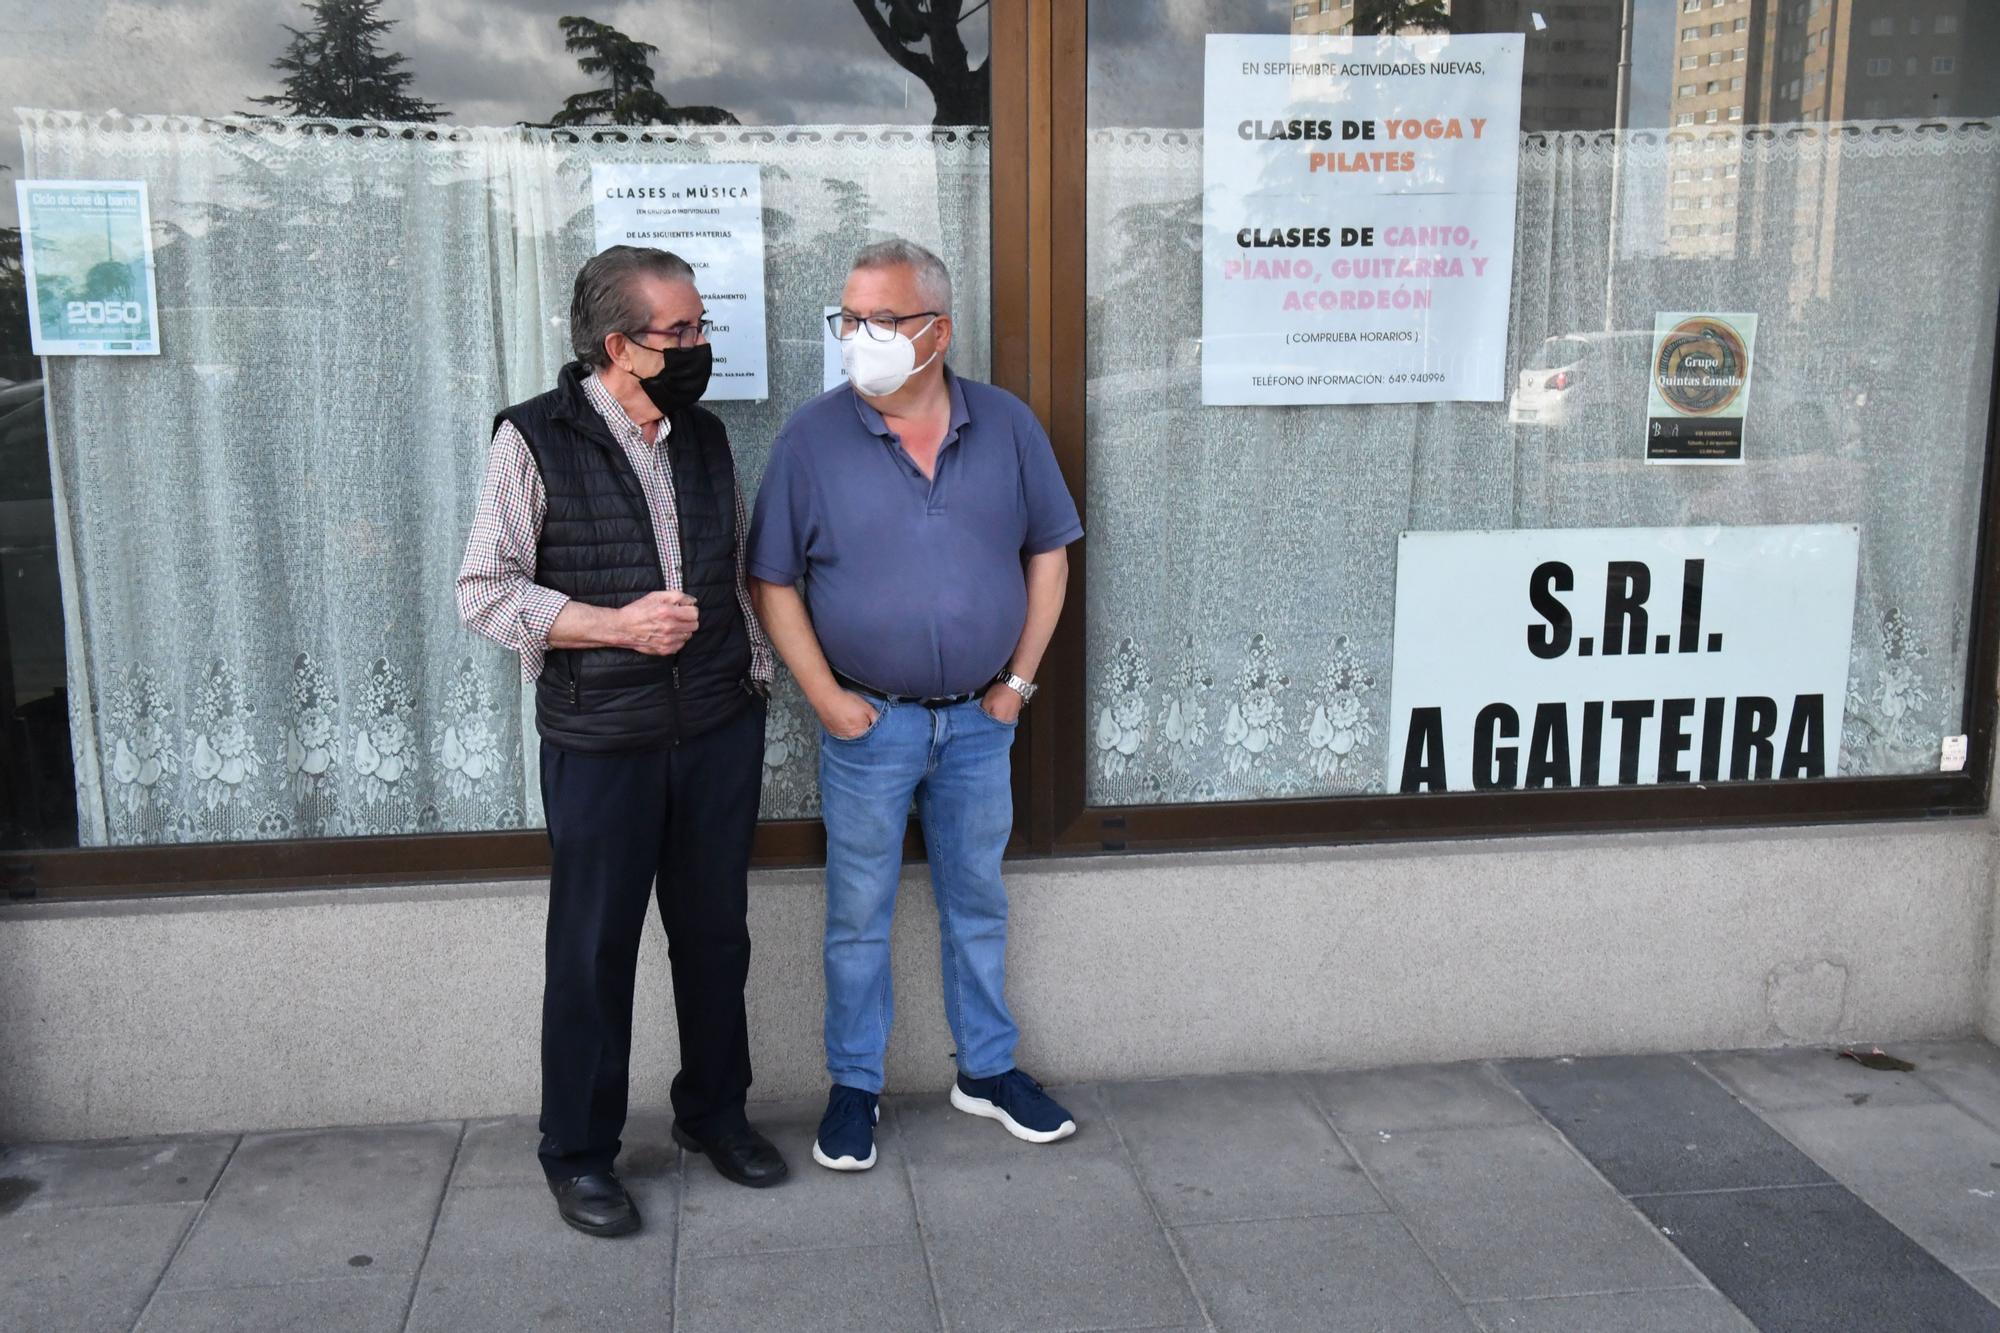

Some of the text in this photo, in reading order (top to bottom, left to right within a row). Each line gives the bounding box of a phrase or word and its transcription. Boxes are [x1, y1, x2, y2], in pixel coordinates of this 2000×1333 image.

[1242, 61, 1485, 77] EN SEPTIEMBRE ACTIVIDADES NUEVAS,
[1237, 118, 1487, 141] CLASES DE YOGA Y
[1309, 151, 1416, 173] PILATES
[606, 185, 749, 199] CLASES DE MÚSICA
[1236, 226, 1479, 250] CLASES DE CANTO,
[1224, 256, 1489, 284] PIANO, GUITARRA Y
[1282, 284, 1433, 311] ACORDEÓN
[67, 301, 143, 324] 2050
[1292, 332, 1357, 343] COMPRUEBA
[1360, 331, 1413, 342] HORARIOS
[1685, 356, 1719, 369] Grupo
[1252, 374, 1304, 386] TELÉFONO
[1307, 373, 1385, 386] INFORMACIÓN:
[1659, 375, 1742, 388] Quintas Canella
[1527, 558, 1723, 660] S.R.I.
[1400, 693, 1826, 793] A GAITEIRA
